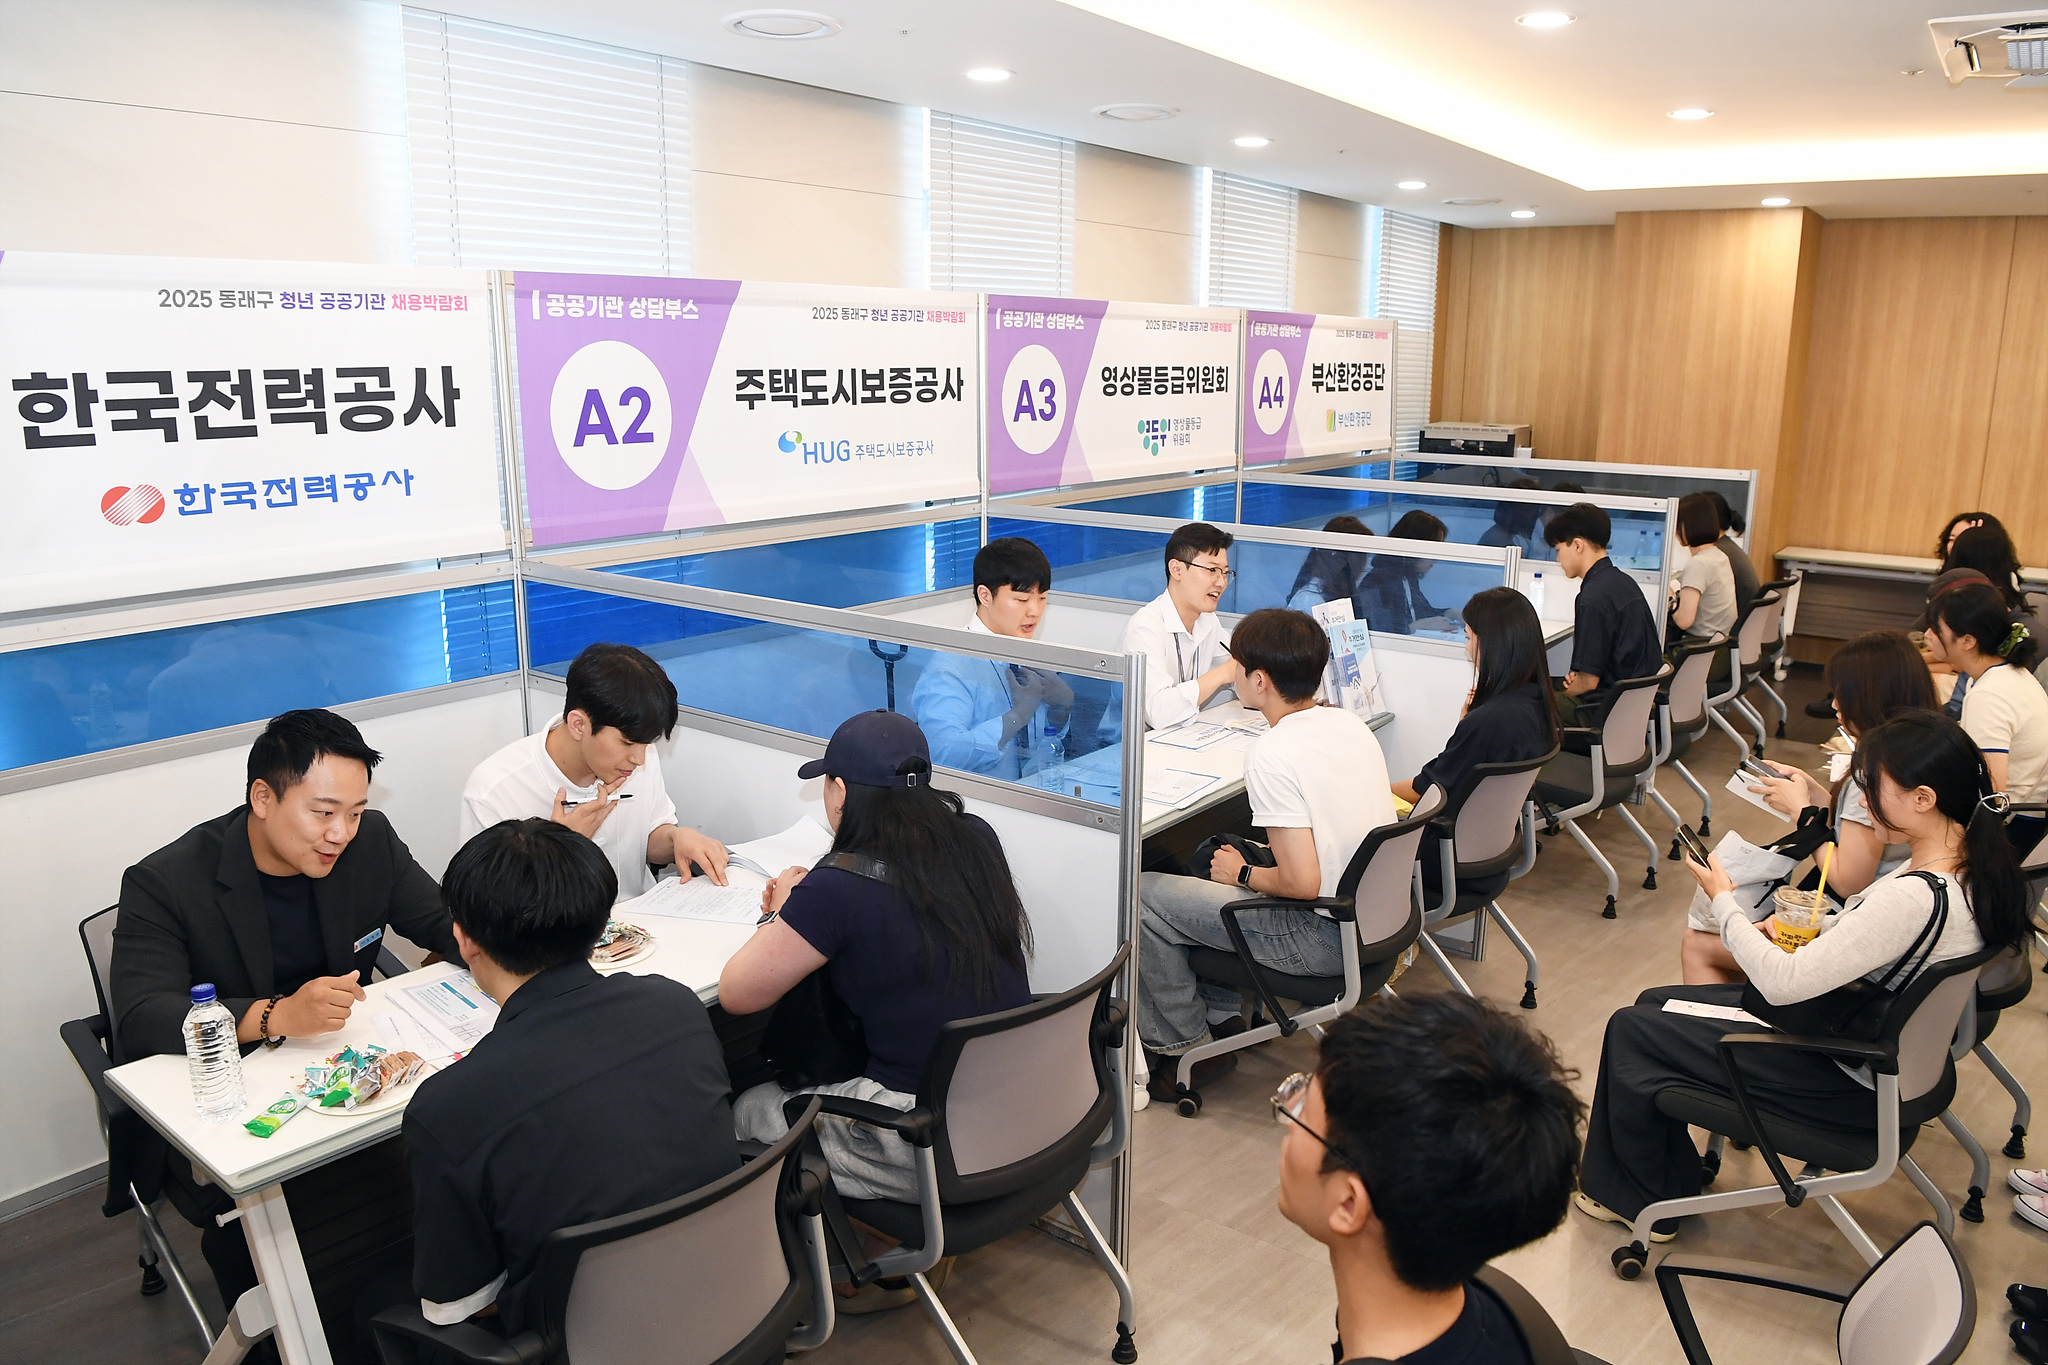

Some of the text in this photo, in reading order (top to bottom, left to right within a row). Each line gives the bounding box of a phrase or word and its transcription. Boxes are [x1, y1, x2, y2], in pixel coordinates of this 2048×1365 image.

[158, 289, 468, 312] 2025 동래구 청년 공공기관 채용박람회
[546, 293, 700, 320] 공공기관 상담부스
[812, 306, 967, 324] 2025 동래구 청년 공공기관 채용박람회
[1003, 310, 1085, 330] 공공기관 상담부스
[1145, 320, 1161, 330] 2025
[1189, 321, 1209, 332] 공공기관
[1254, 322, 1279, 338] 공공기관
[735, 366, 964, 410] 주택도시보증공사
[1101, 365, 1229, 397] 영상물등급위원회
[1312, 362, 1386, 393] 부산환경공단
[1013, 378, 1057, 422] A3
[1258, 376, 1284, 409] A4
[12, 366, 461, 450] 한국전력공사
[573, 386, 654, 448] A2
[1338, 411, 1372, 428] 부산환경공단
[1173, 417, 1202, 431] 영상물등급
[803, 440, 934, 465] HUG 주택도시보증공사
[1173, 433, 1191, 446] 위원회
[173, 469, 414, 516] 한국전력공사
